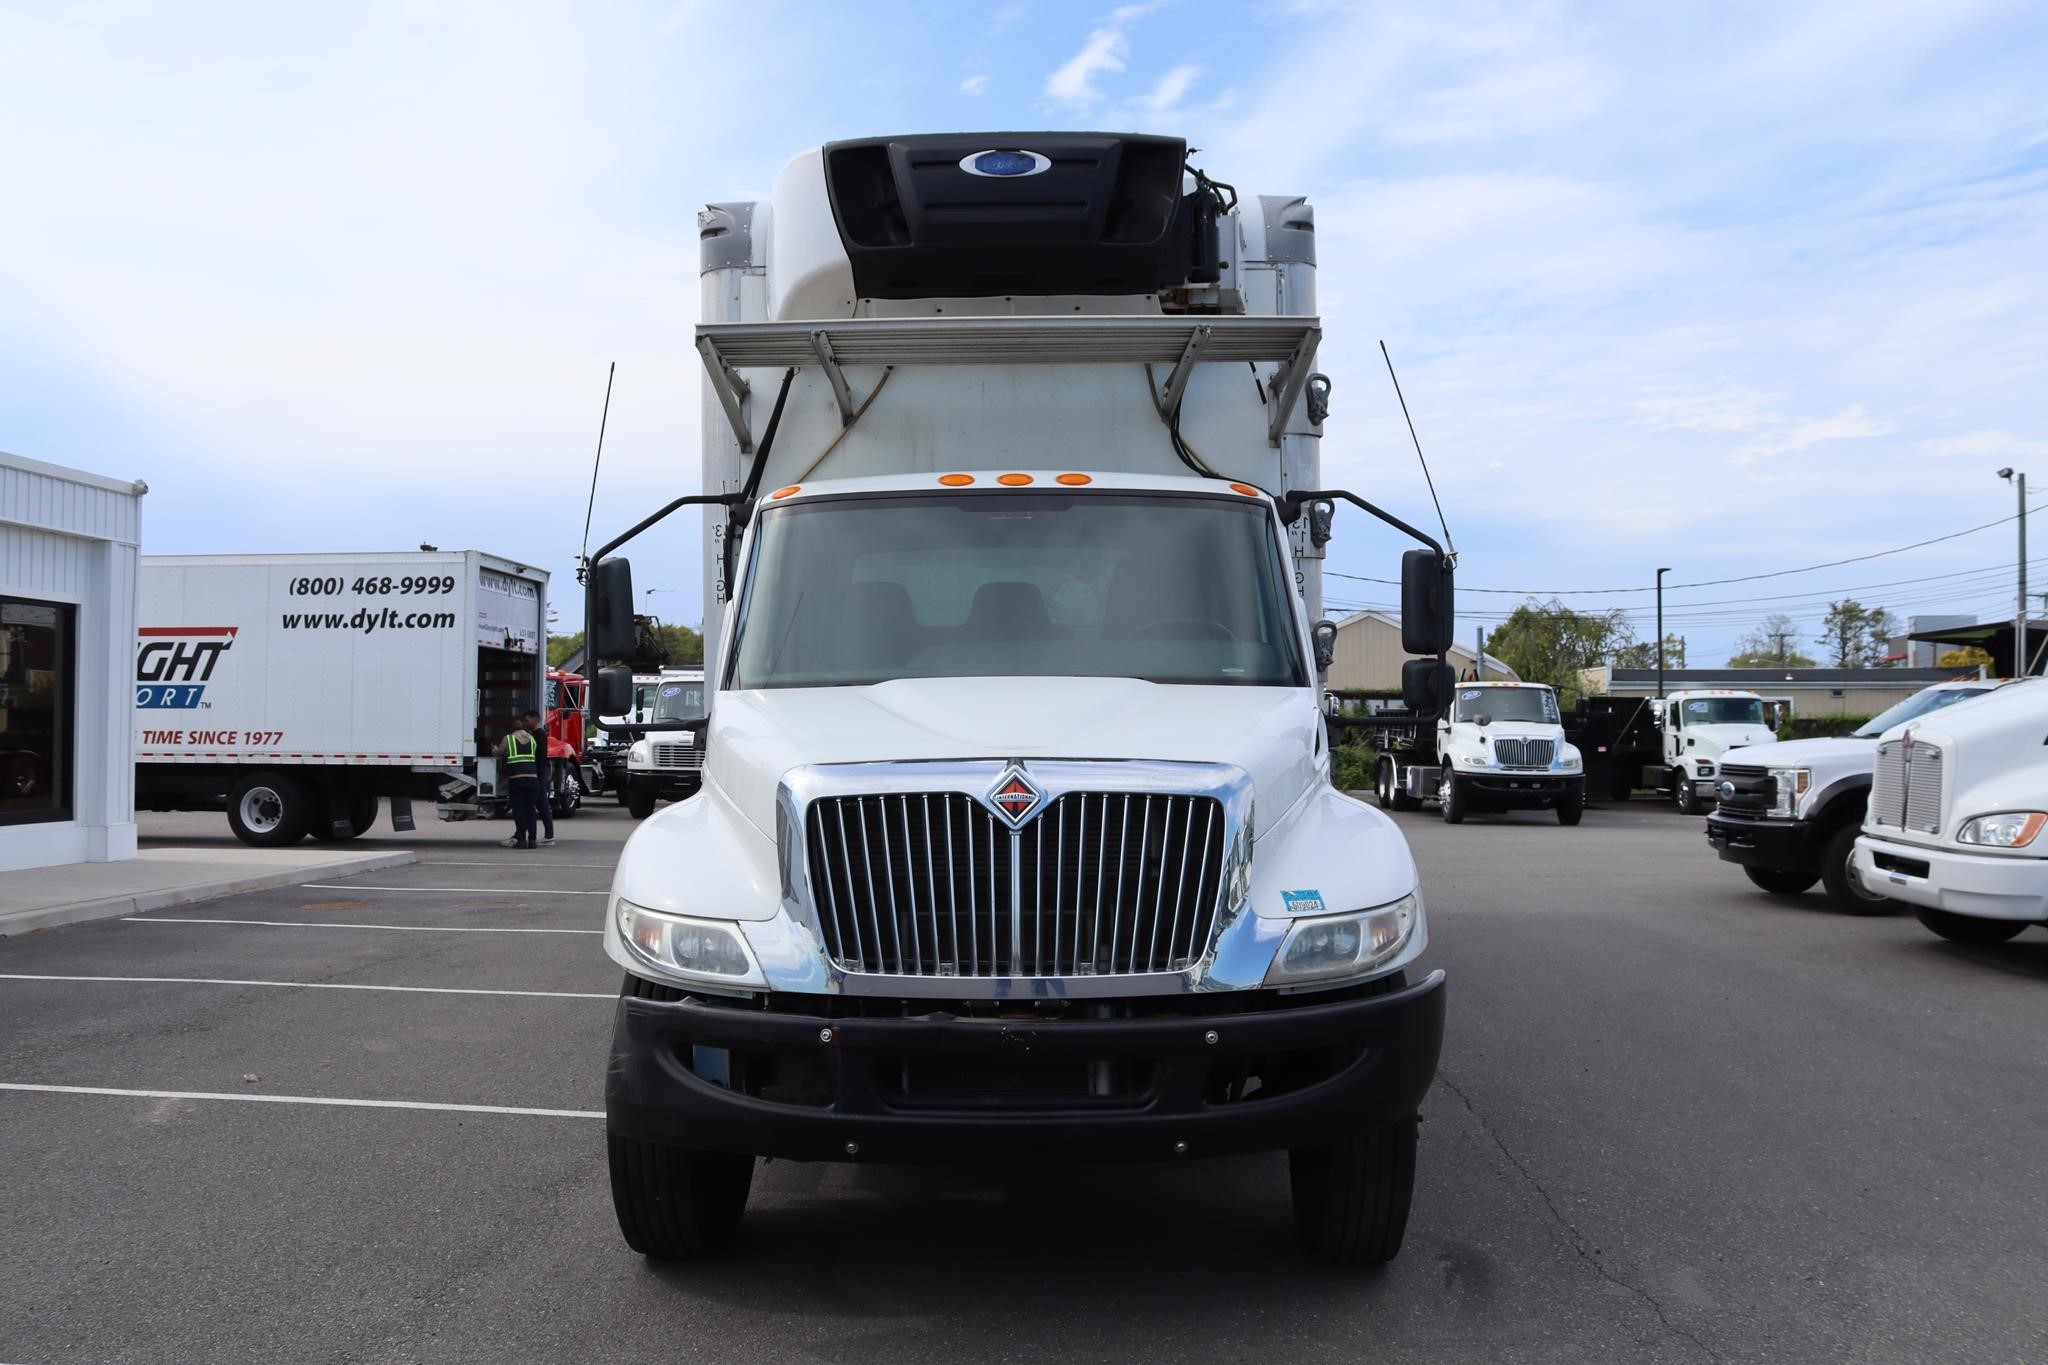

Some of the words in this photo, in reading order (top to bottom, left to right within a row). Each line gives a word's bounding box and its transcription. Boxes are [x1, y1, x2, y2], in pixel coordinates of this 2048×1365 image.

[289, 577, 344, 596] (800)
[351, 576, 455, 595] 468-9999
[282, 608, 455, 634] www.dylt.com
[136, 640, 234, 682] GHT
[143, 731, 183, 744] TIME
[188, 731, 238, 745] SINCE
[244, 732, 284, 745] 1977
